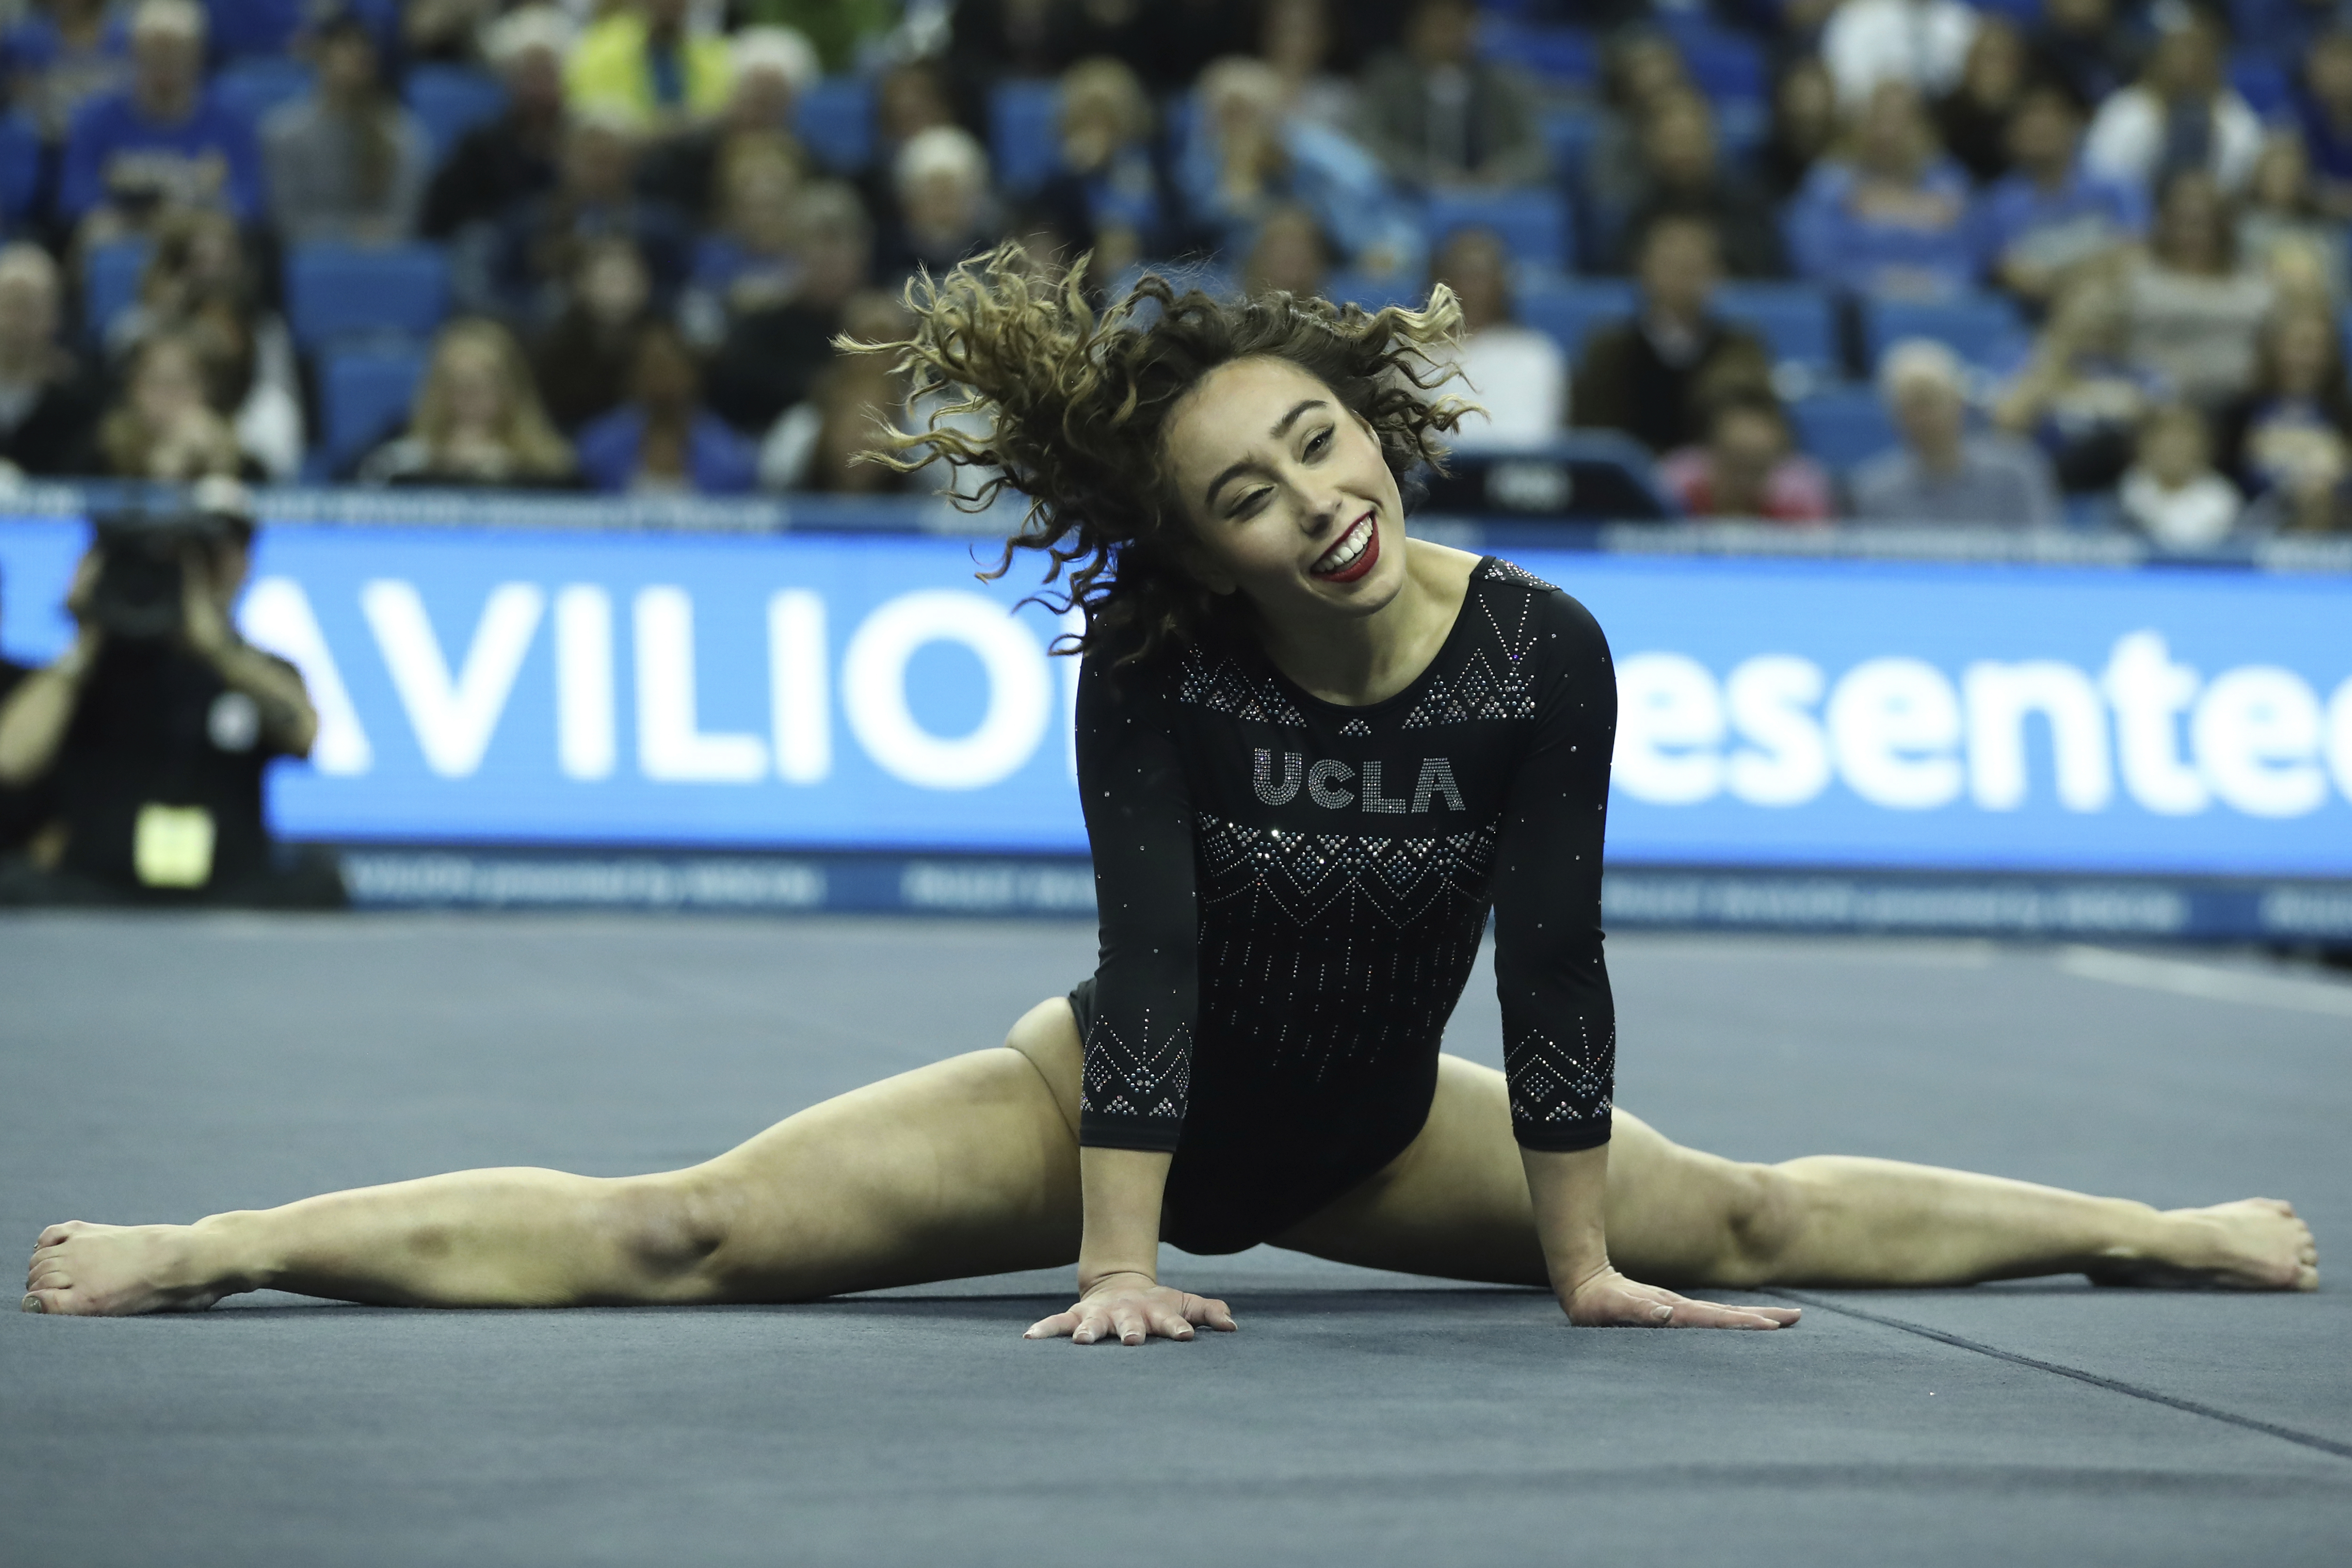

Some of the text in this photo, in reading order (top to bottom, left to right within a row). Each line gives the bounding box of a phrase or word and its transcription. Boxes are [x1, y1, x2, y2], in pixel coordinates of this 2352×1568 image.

[240, 576, 2352, 817] AVILIO esente
[1253, 747, 1466, 814] UCLA
